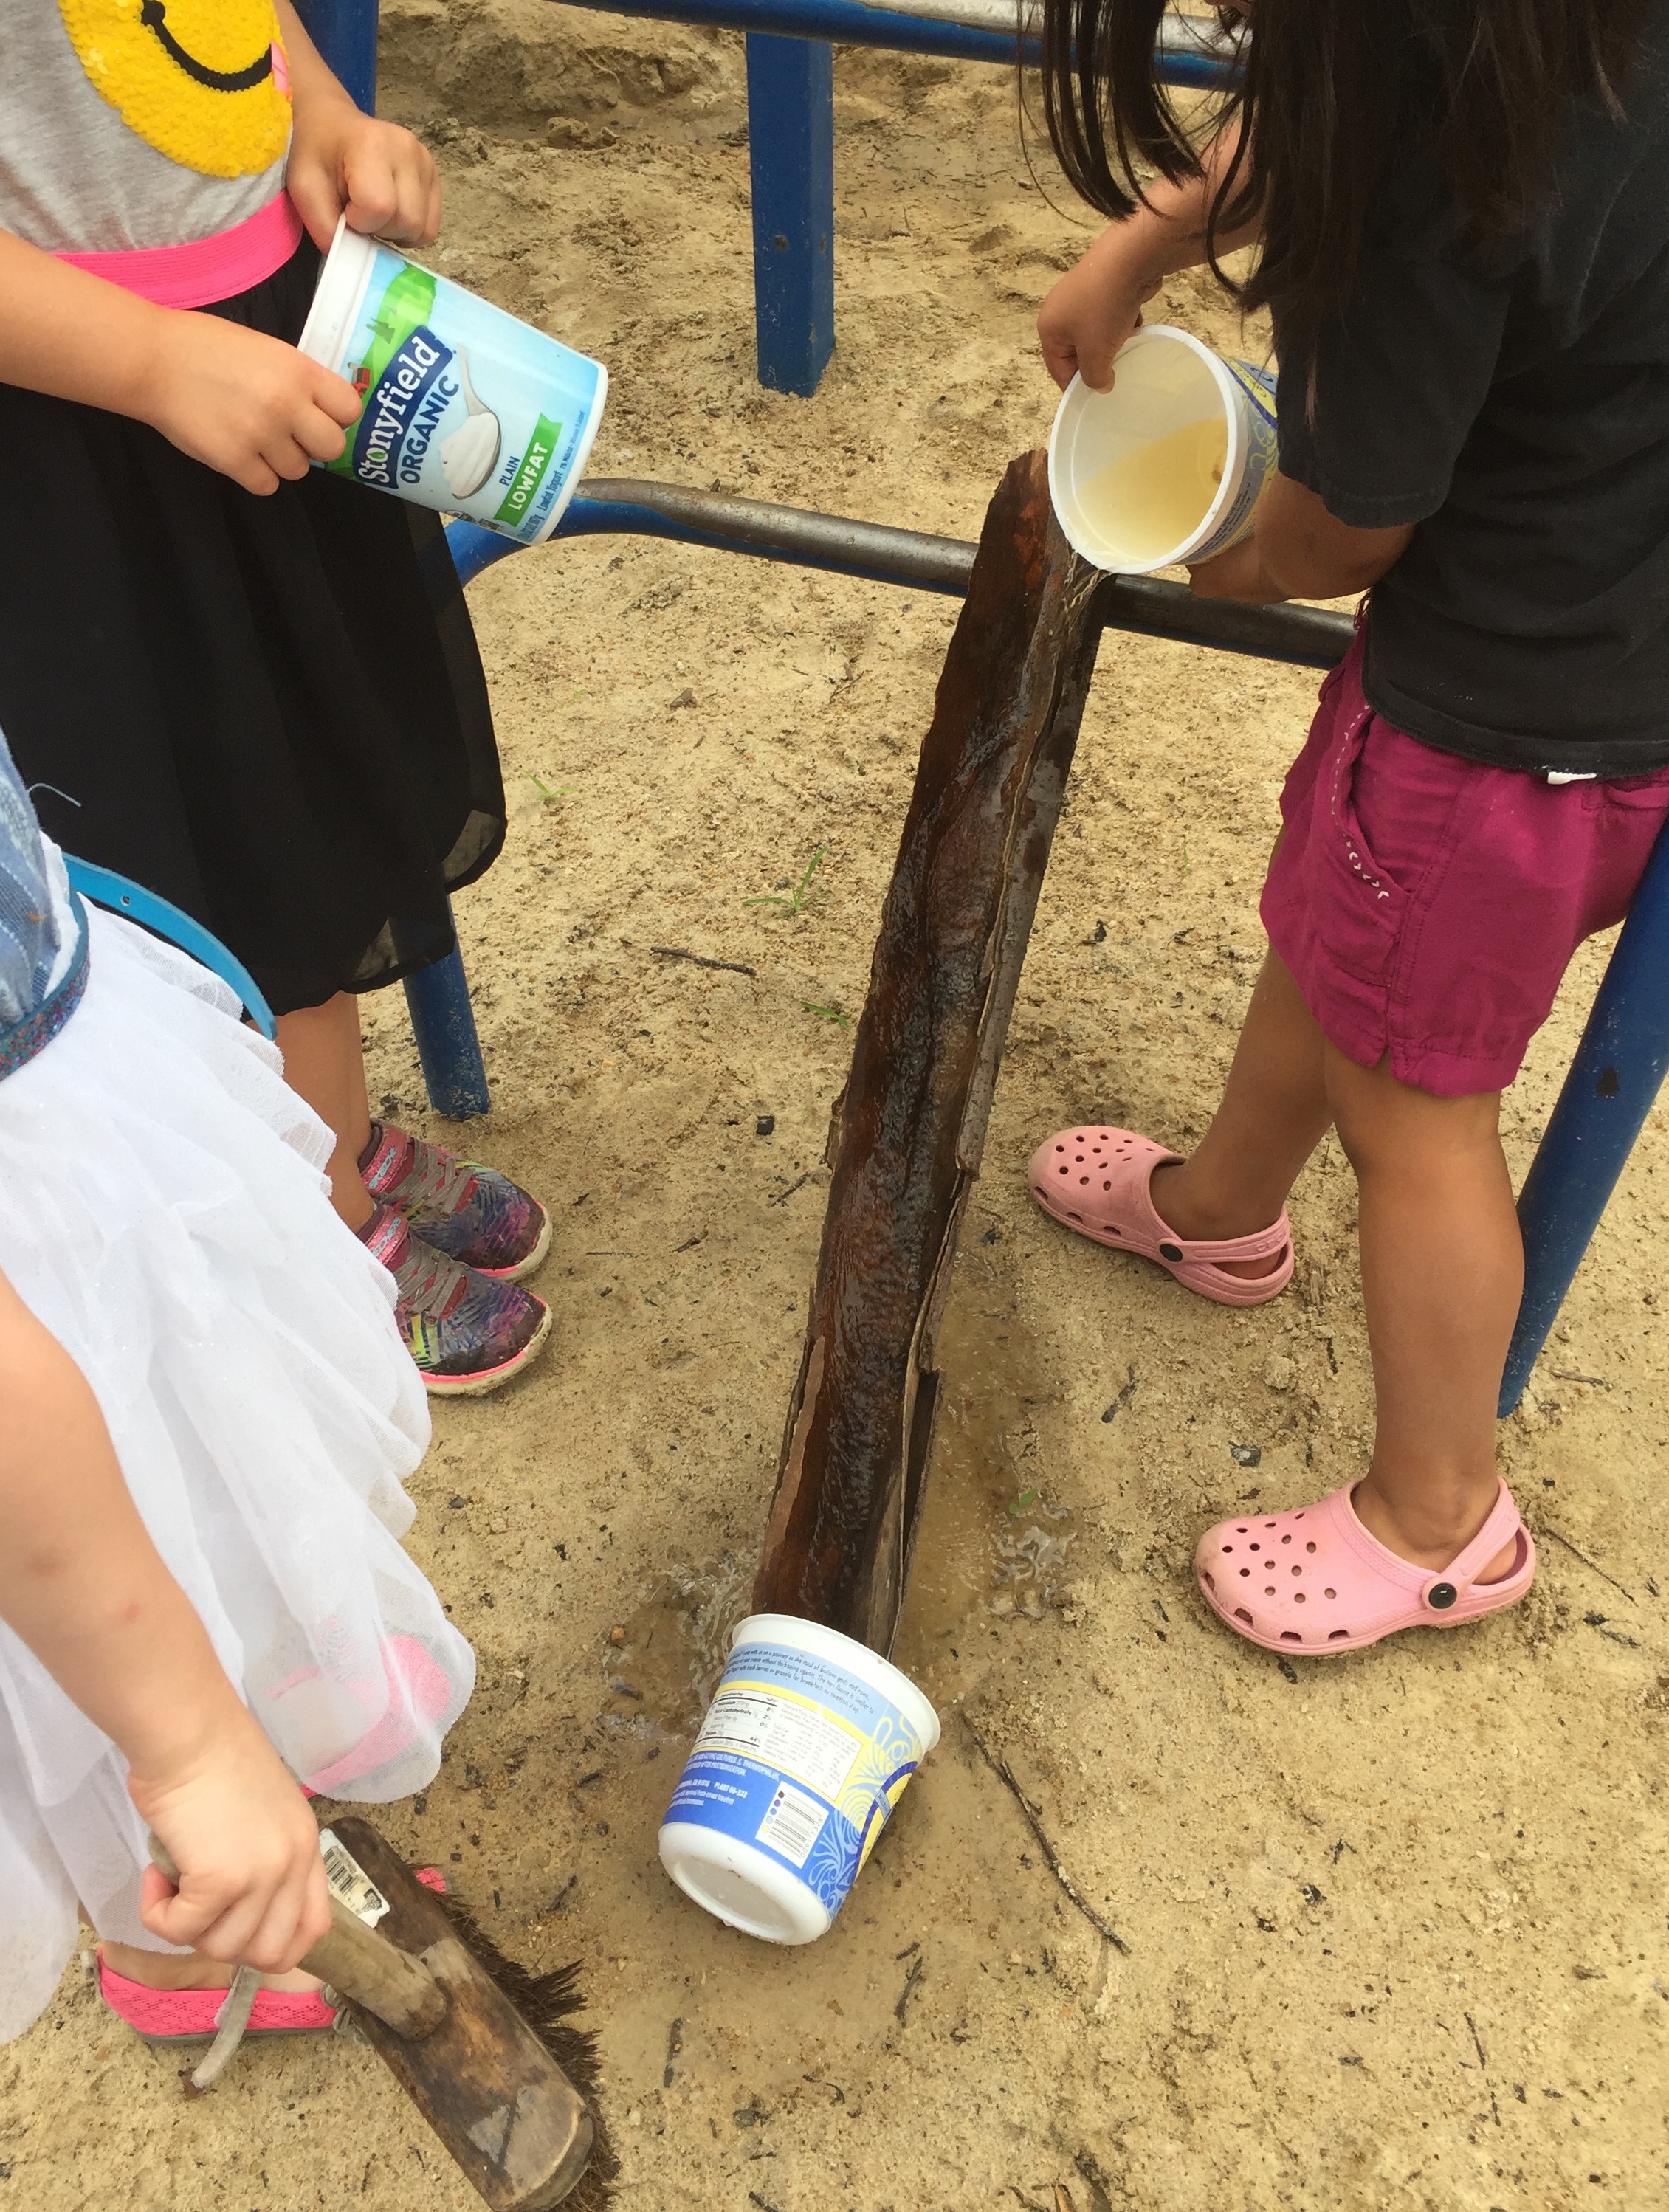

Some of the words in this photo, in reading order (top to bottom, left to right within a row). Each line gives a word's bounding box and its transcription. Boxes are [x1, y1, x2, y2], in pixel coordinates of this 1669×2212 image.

[358, 335, 441, 483] Stonyfield
[400, 375, 460, 484] ORGANIC
[500, 456, 520, 486] PLAIN
[508, 441, 548, 511] LOWFAT
[536, 489, 554, 511] Lowfat
[545, 470, 563, 492] Yogurt
[723, 1707, 752, 1715] Carbohydrate
[743, 1759, 780, 1782] THERMOPHILUS,
[713, 1782, 729, 1792] PLANT
[717, 1794, 735, 1805] treated
